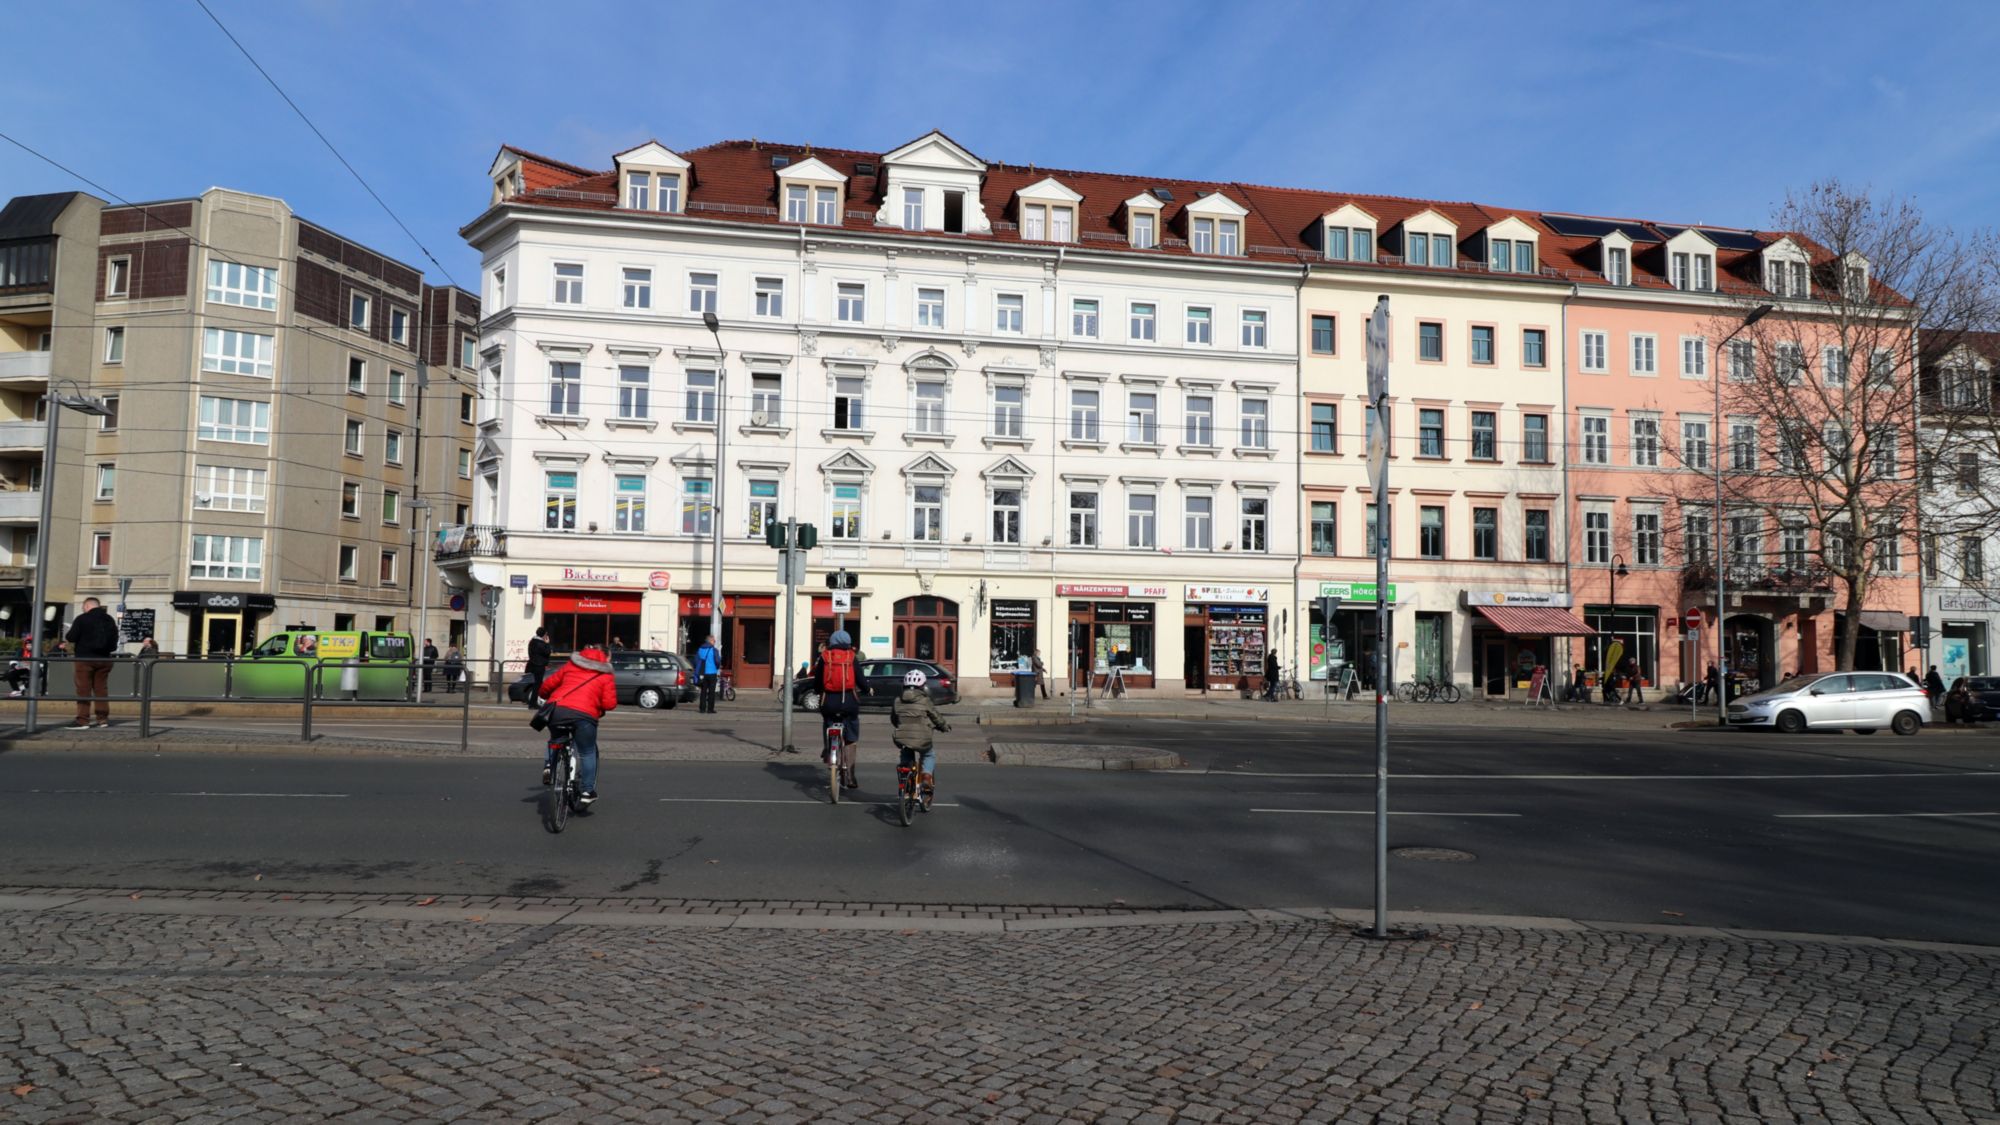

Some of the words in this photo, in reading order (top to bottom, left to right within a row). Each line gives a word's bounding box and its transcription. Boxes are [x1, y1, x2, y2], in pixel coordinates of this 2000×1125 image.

[564, 568, 618, 580] Bäckerei
[1073, 585, 1123, 593] NÄHZENTRUM
[687, 599, 705, 609] Cafe
[332, 637, 355, 647] TKH
[385, 637, 405, 647] TKH
